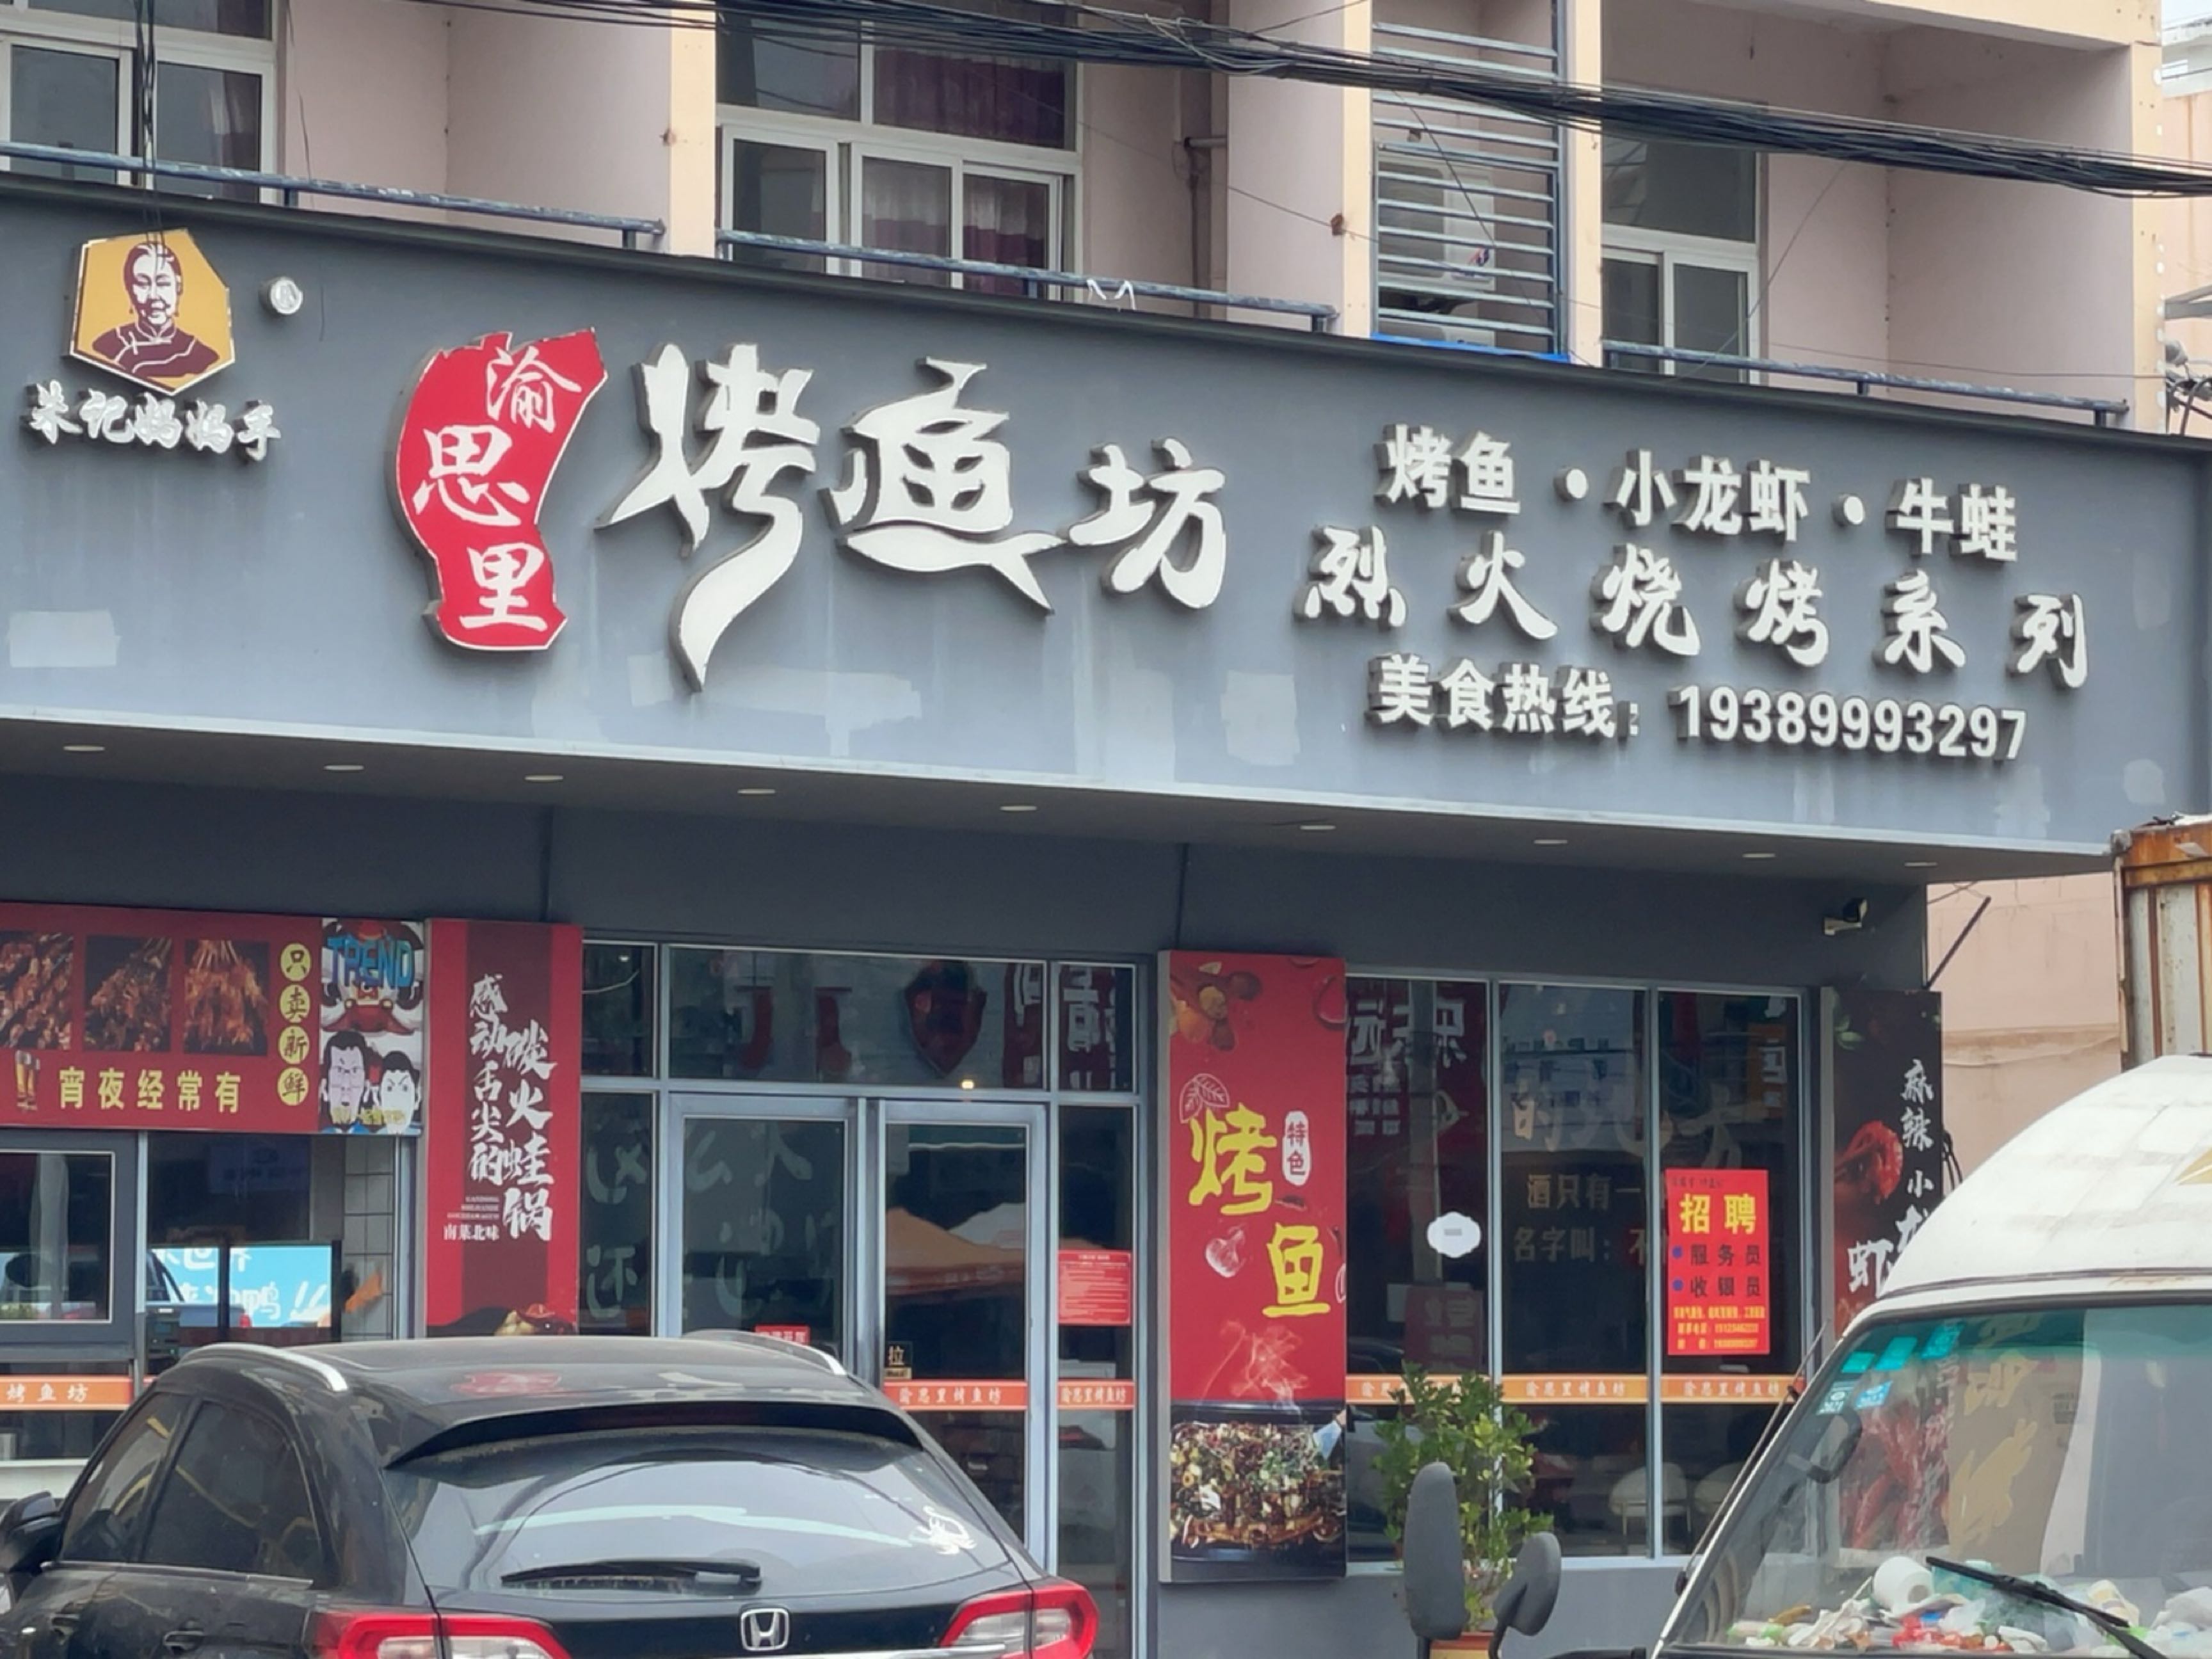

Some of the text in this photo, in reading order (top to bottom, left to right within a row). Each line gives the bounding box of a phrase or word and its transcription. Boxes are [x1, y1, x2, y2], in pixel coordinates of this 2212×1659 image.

[413, 346, 581, 632] 渝思里
[1301, 525, 2088, 688] 烈火烧烤系列
[1676, 685, 2026, 760] 19389993297
[281, 947, 309, 1105] 只卖新鲜
[59, 1066, 241, 1112] 宵夜经常有
[469, 974, 507, 1185] 感动舌尖的
[1286, 1121, 1307, 1176] 特色
[1188, 1102, 1331, 1318] 烤鱼
[1527, 1173, 1664, 1210] 酒只有一
[1679, 1193, 1756, 1235] 招聘
[1691, 1244, 1760, 1266] 服务员
[1690, 1276, 1760, 1297] 收银员
[888, 1345, 904, 1365] 拉
[6, 1382, 89, 1403] 烤鱼坊
